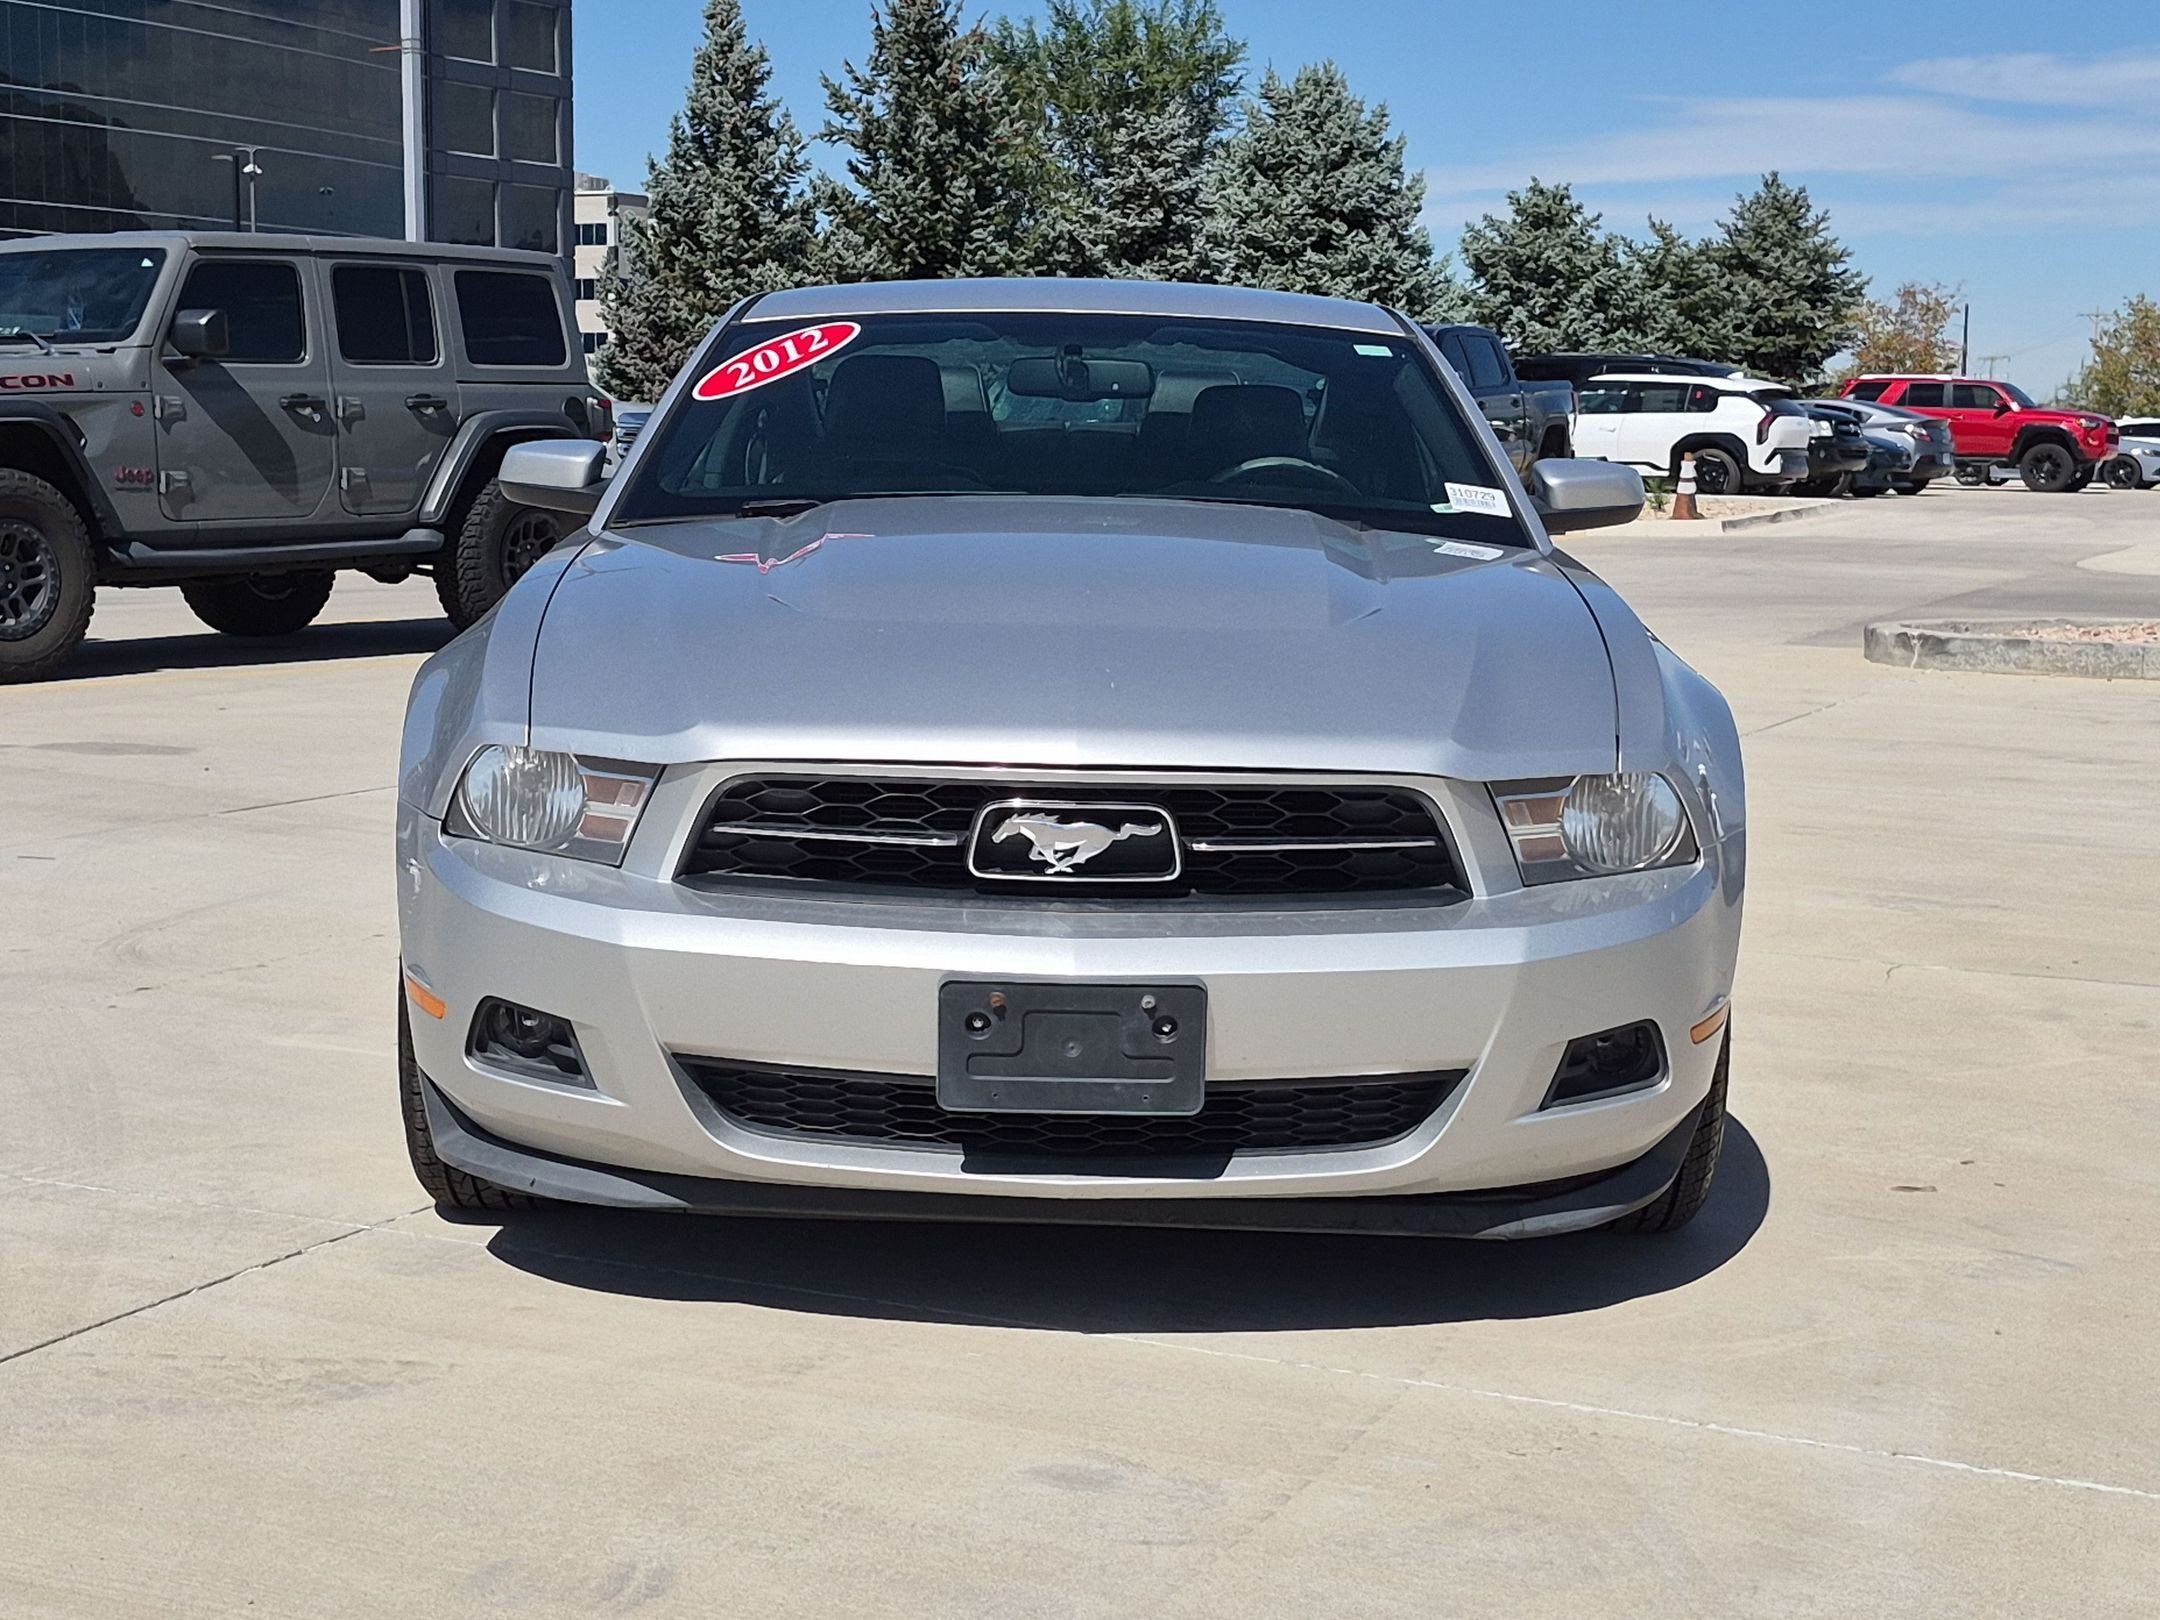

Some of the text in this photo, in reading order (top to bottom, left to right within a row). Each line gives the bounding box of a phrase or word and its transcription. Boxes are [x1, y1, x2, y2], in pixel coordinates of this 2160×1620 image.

[726, 328, 829, 388] 2012
[113, 465, 154, 485] Jeep
[1449, 487, 1496, 501] 310729
